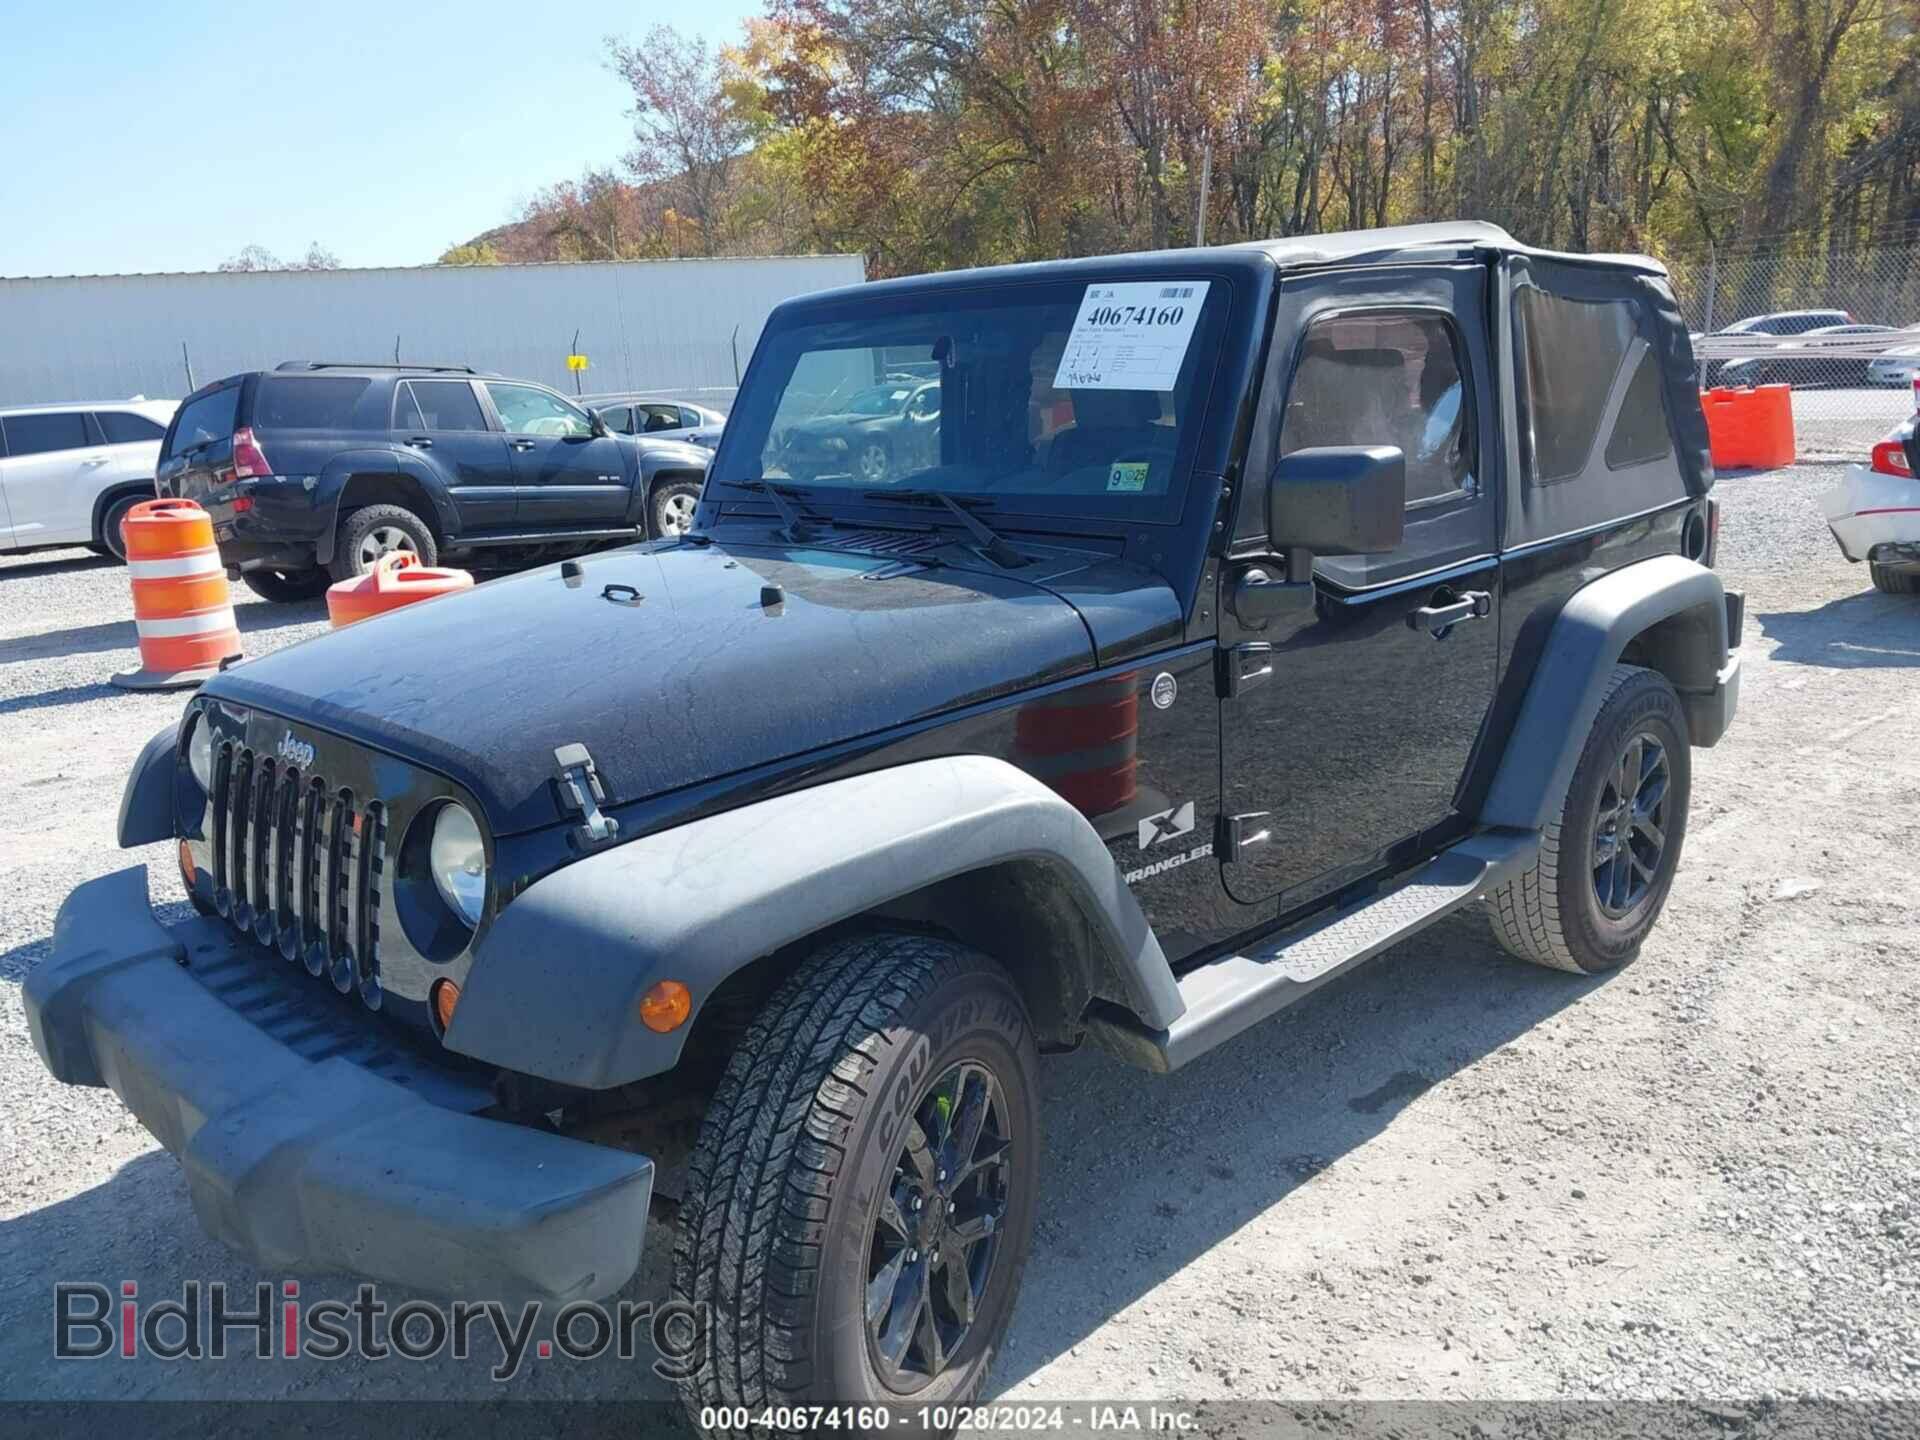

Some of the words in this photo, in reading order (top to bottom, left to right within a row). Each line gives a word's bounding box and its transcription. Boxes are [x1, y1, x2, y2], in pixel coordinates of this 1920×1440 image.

[1087, 306, 1184, 325] 40674160
[1112, 470, 1121, 486] 9
[277, 730, 314, 771] Jeep
